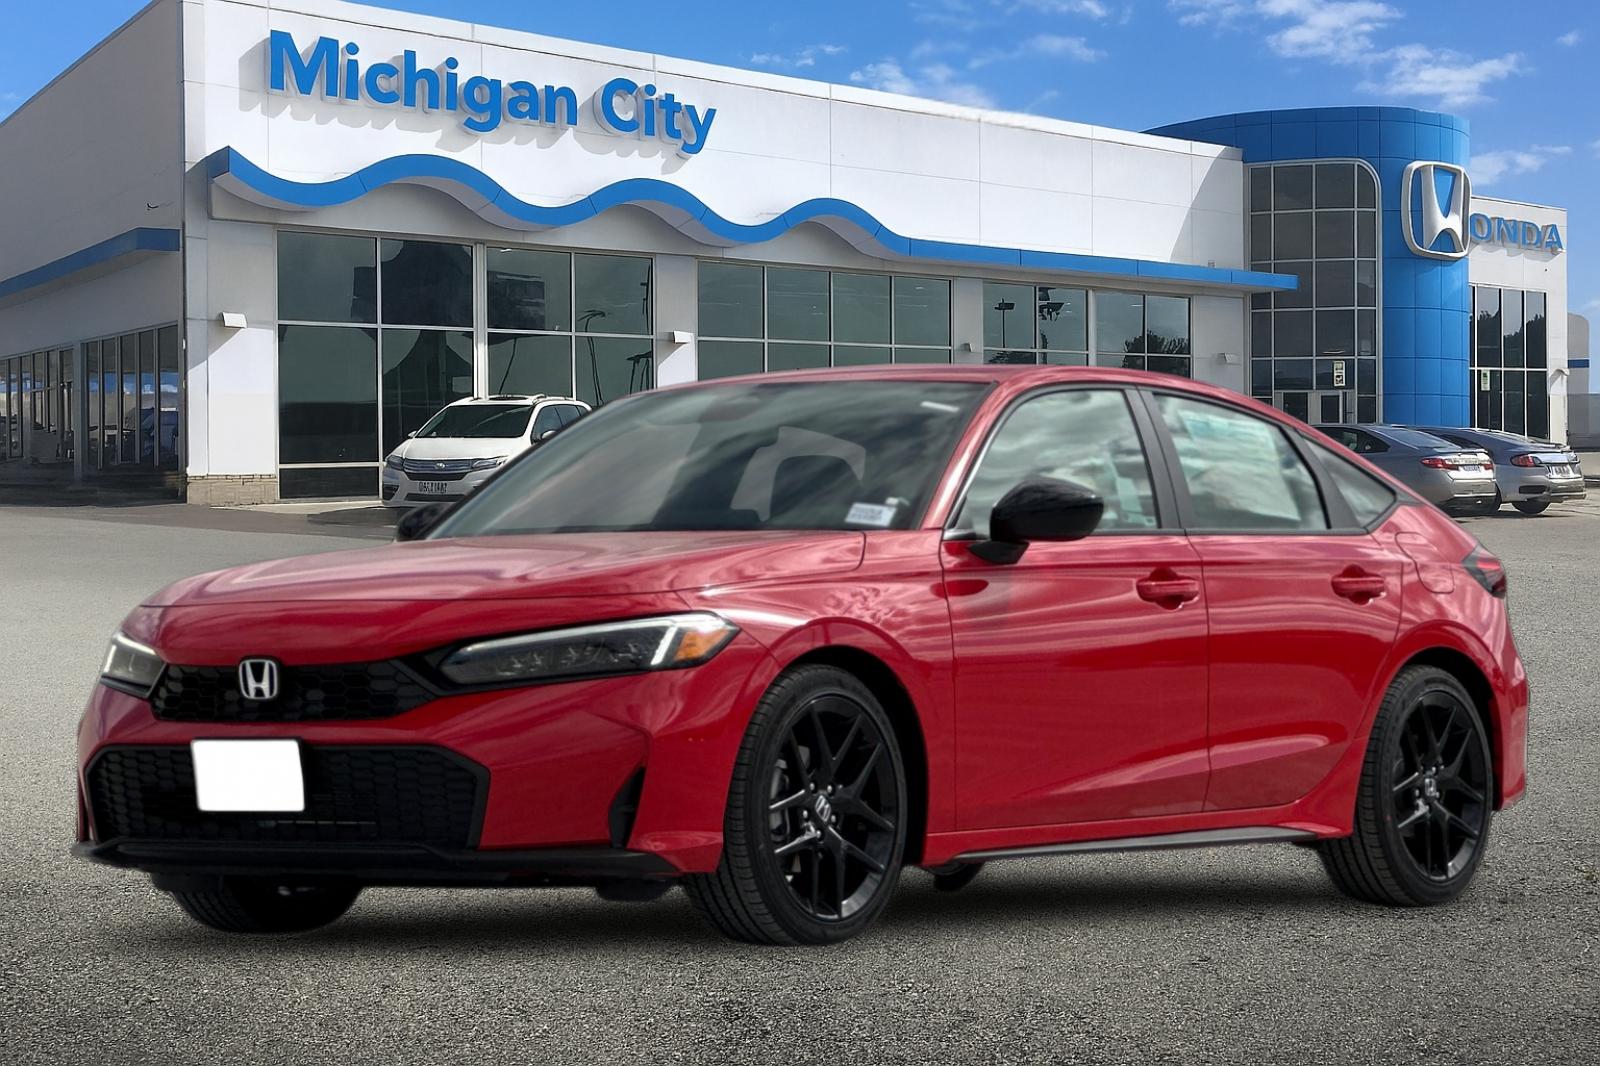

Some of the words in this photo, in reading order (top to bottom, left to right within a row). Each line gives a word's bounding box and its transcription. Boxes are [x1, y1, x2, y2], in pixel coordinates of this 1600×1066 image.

[268, 29, 579, 134] Michigan
[599, 77, 717, 155] City
[1470, 213, 1564, 250] ONDA
